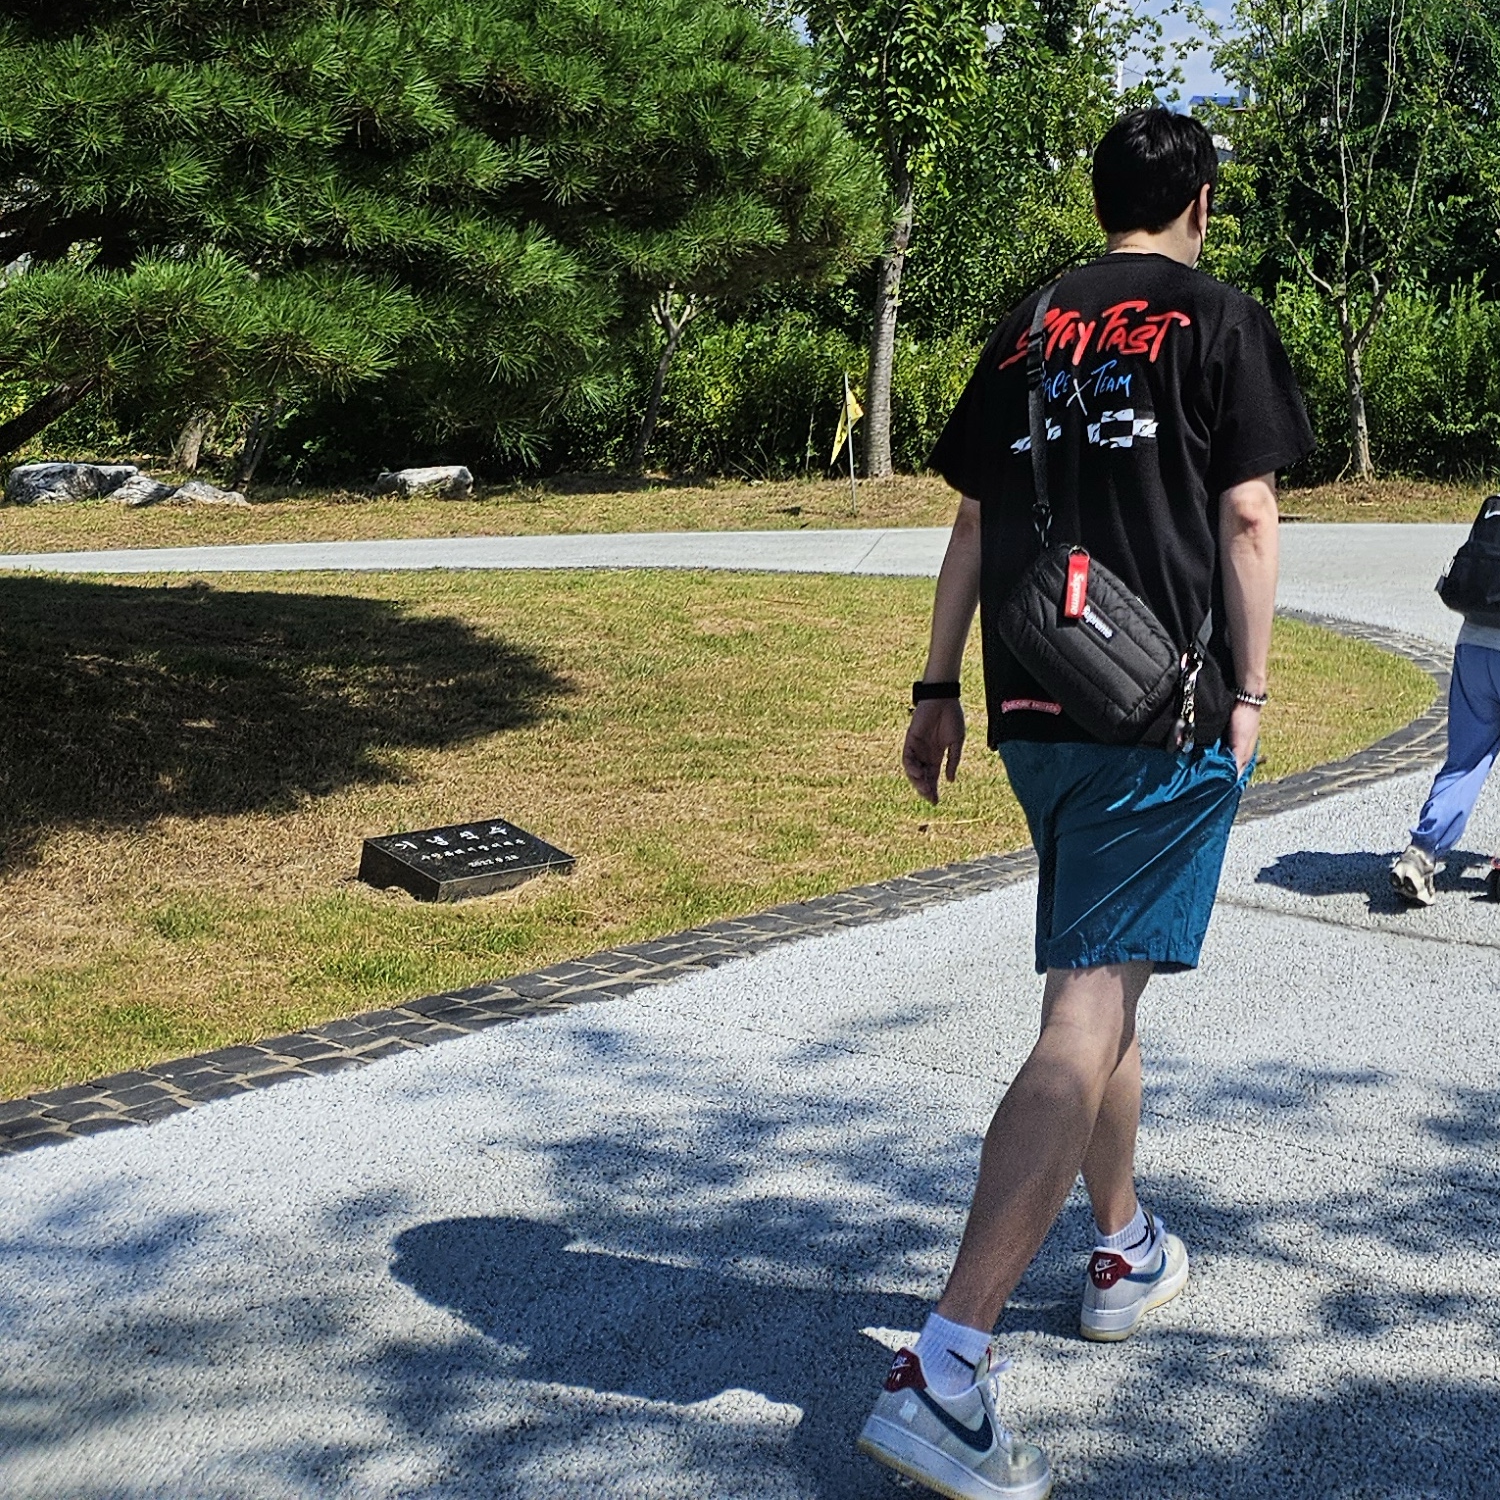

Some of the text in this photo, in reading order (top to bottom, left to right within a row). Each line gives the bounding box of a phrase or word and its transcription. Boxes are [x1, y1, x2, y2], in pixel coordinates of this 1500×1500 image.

[1096, 300, 1191, 363] FAST
[1090, 359, 1132, 398] TEAM
[1070, 571, 1084, 616] Supreme
[1081, 604, 1114, 639] Supreme
[1095, 1272, 1112, 1280] AIR
